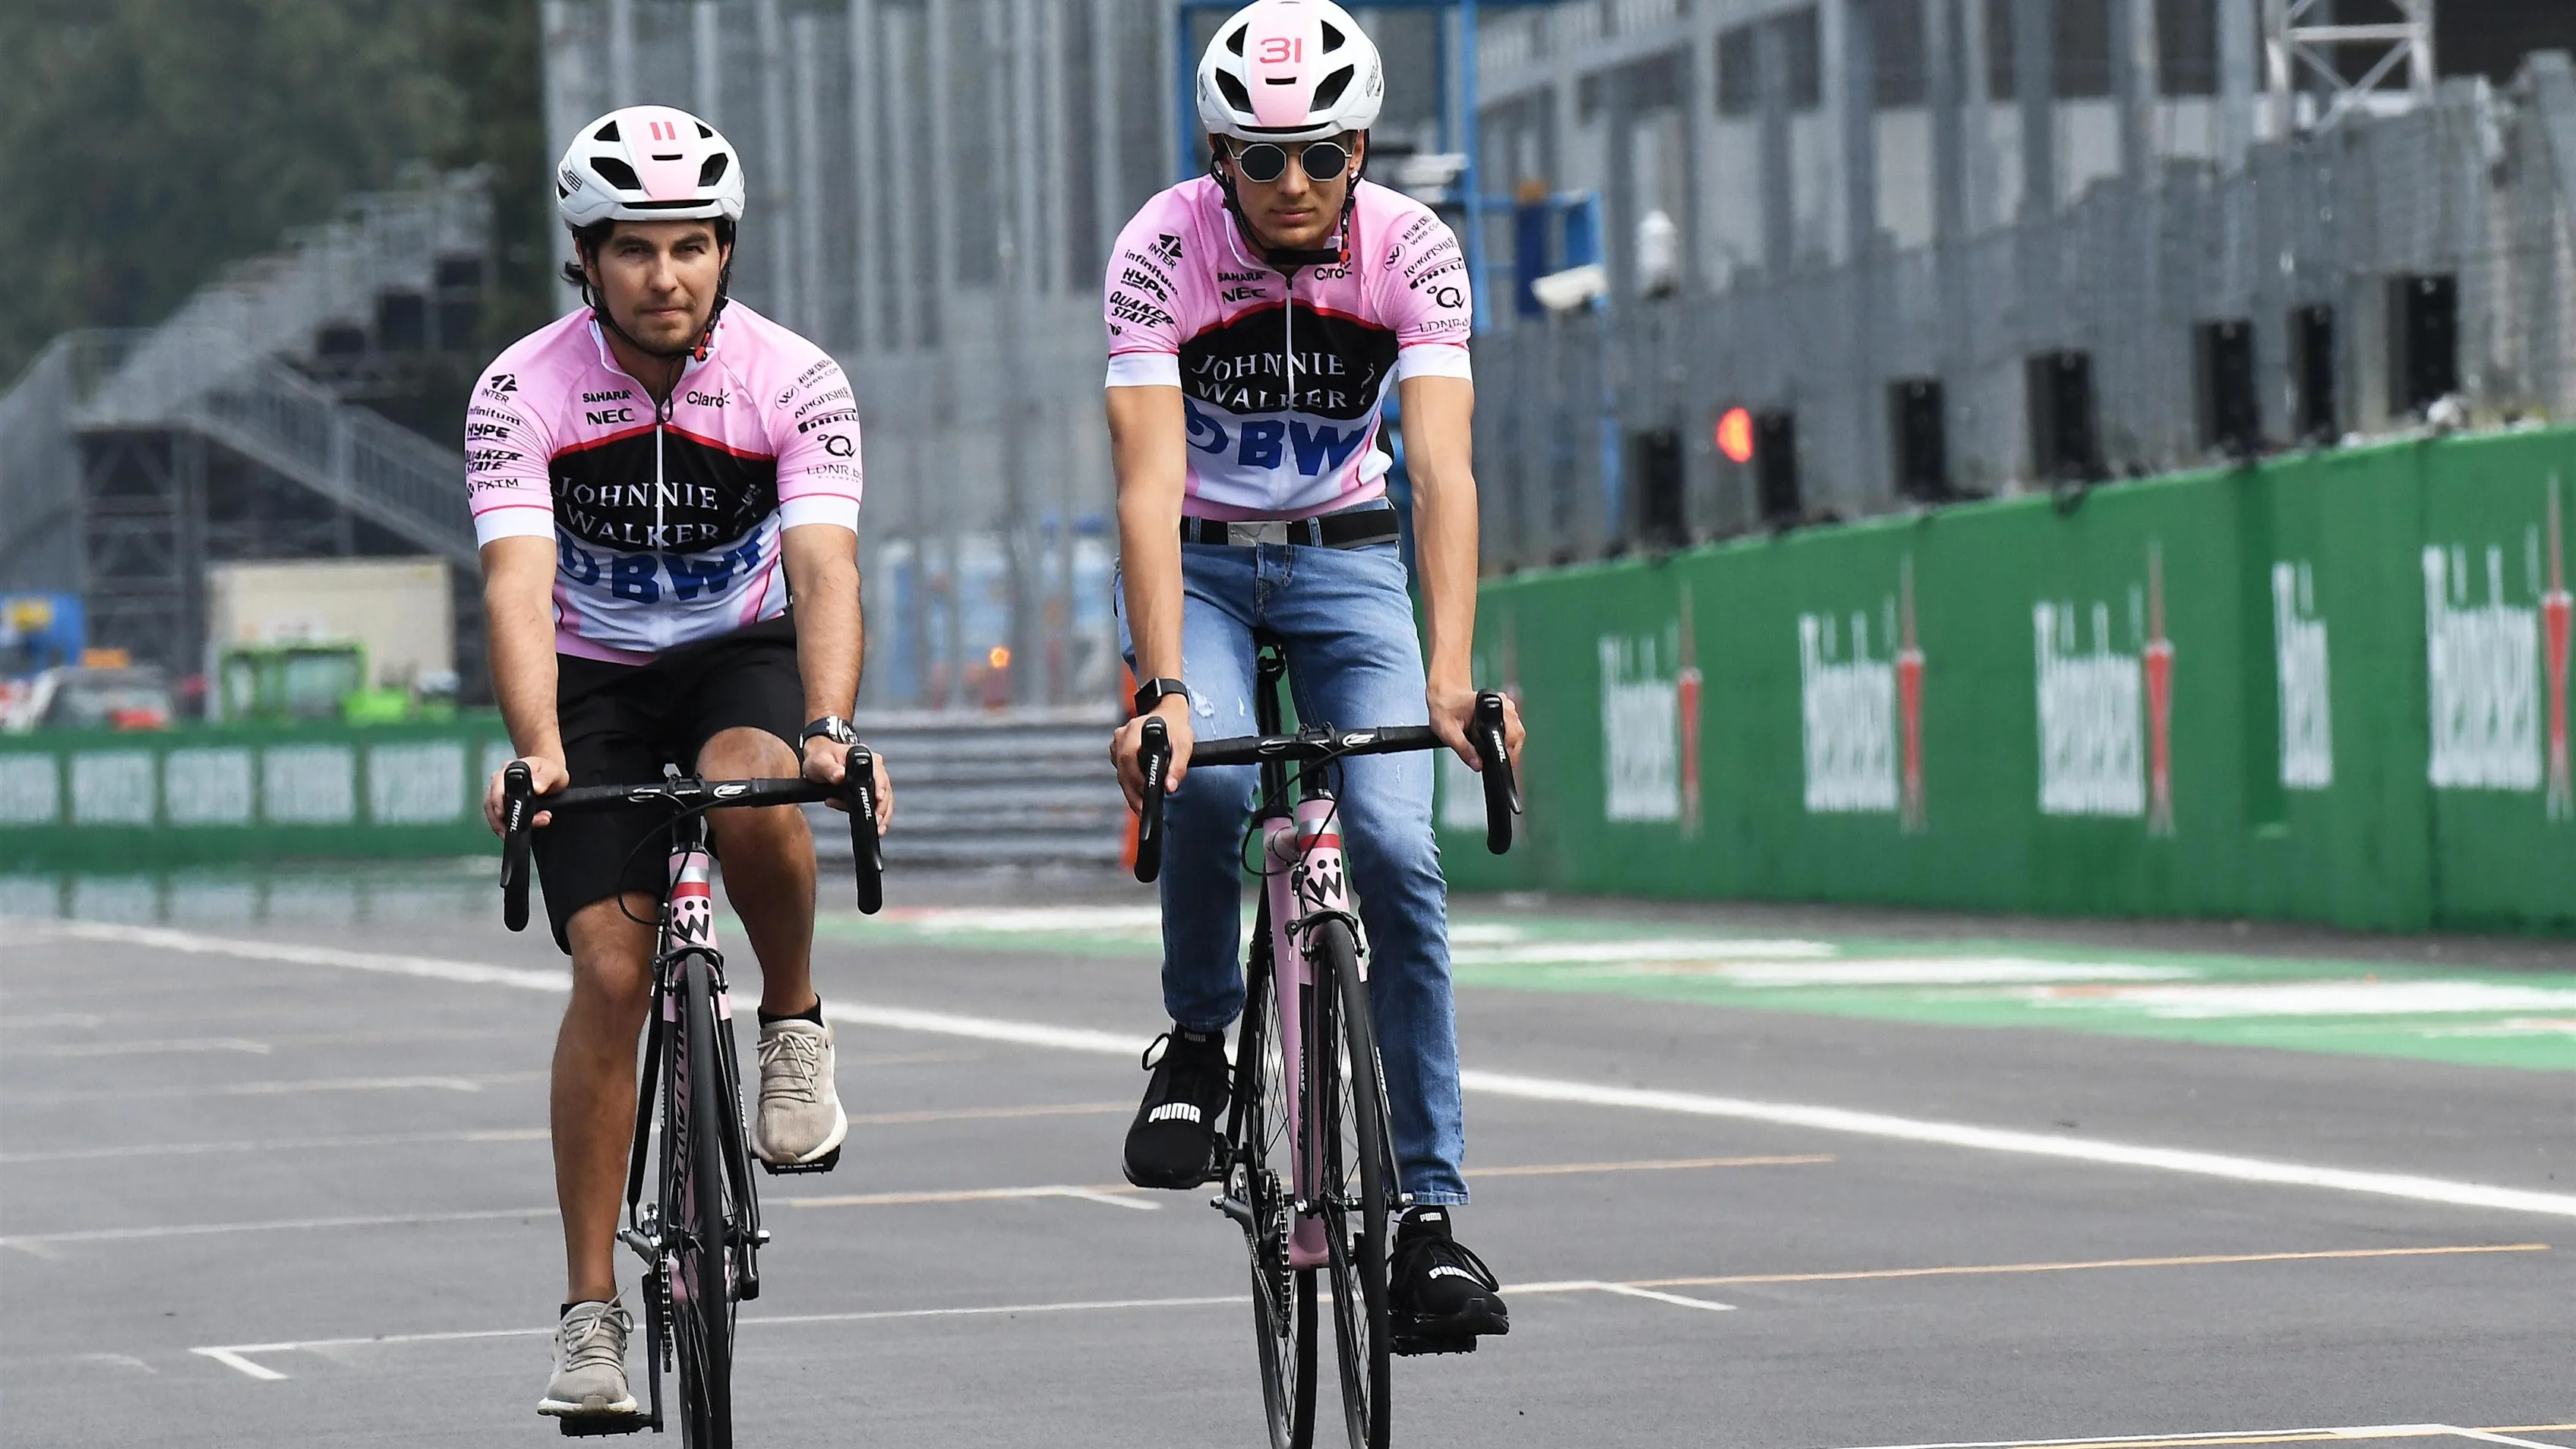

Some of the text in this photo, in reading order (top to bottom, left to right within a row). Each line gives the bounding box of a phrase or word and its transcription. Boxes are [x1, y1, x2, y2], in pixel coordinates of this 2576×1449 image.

[1260, 37, 1302, 64] 31
[1148, 242, 1176, 270] INTER
[1122, 267, 1168, 302] HYPE
[1217, 271, 1264, 283] SAHARA
[1110, 291, 1175, 324] QUAKER
[1222, 286, 1267, 305] NEC
[1111, 306, 1162, 328] STATE
[1191, 352, 1346, 381] JOHNNIE
[481, 388, 510, 403] INTER
[582, 390, 629, 403] SAHARA
[687, 391, 724, 408] Claro
[1198, 380, 1348, 410] WALKER
[586, 408, 635, 426] NEC
[467, 422, 510, 439] HYPE
[477, 478, 519, 493] FXTM
[554, 476, 719, 511] JOHNNIE
[565, 503, 720, 548] WALKER
[1148, 753, 1160, 788] RIVAL
[509, 799, 522, 833] RIVAL
[859, 787, 873, 821] RIVAL
[1148, 1102, 1201, 1124] PUMA
[1419, 1211, 1442, 1223] PUMA
